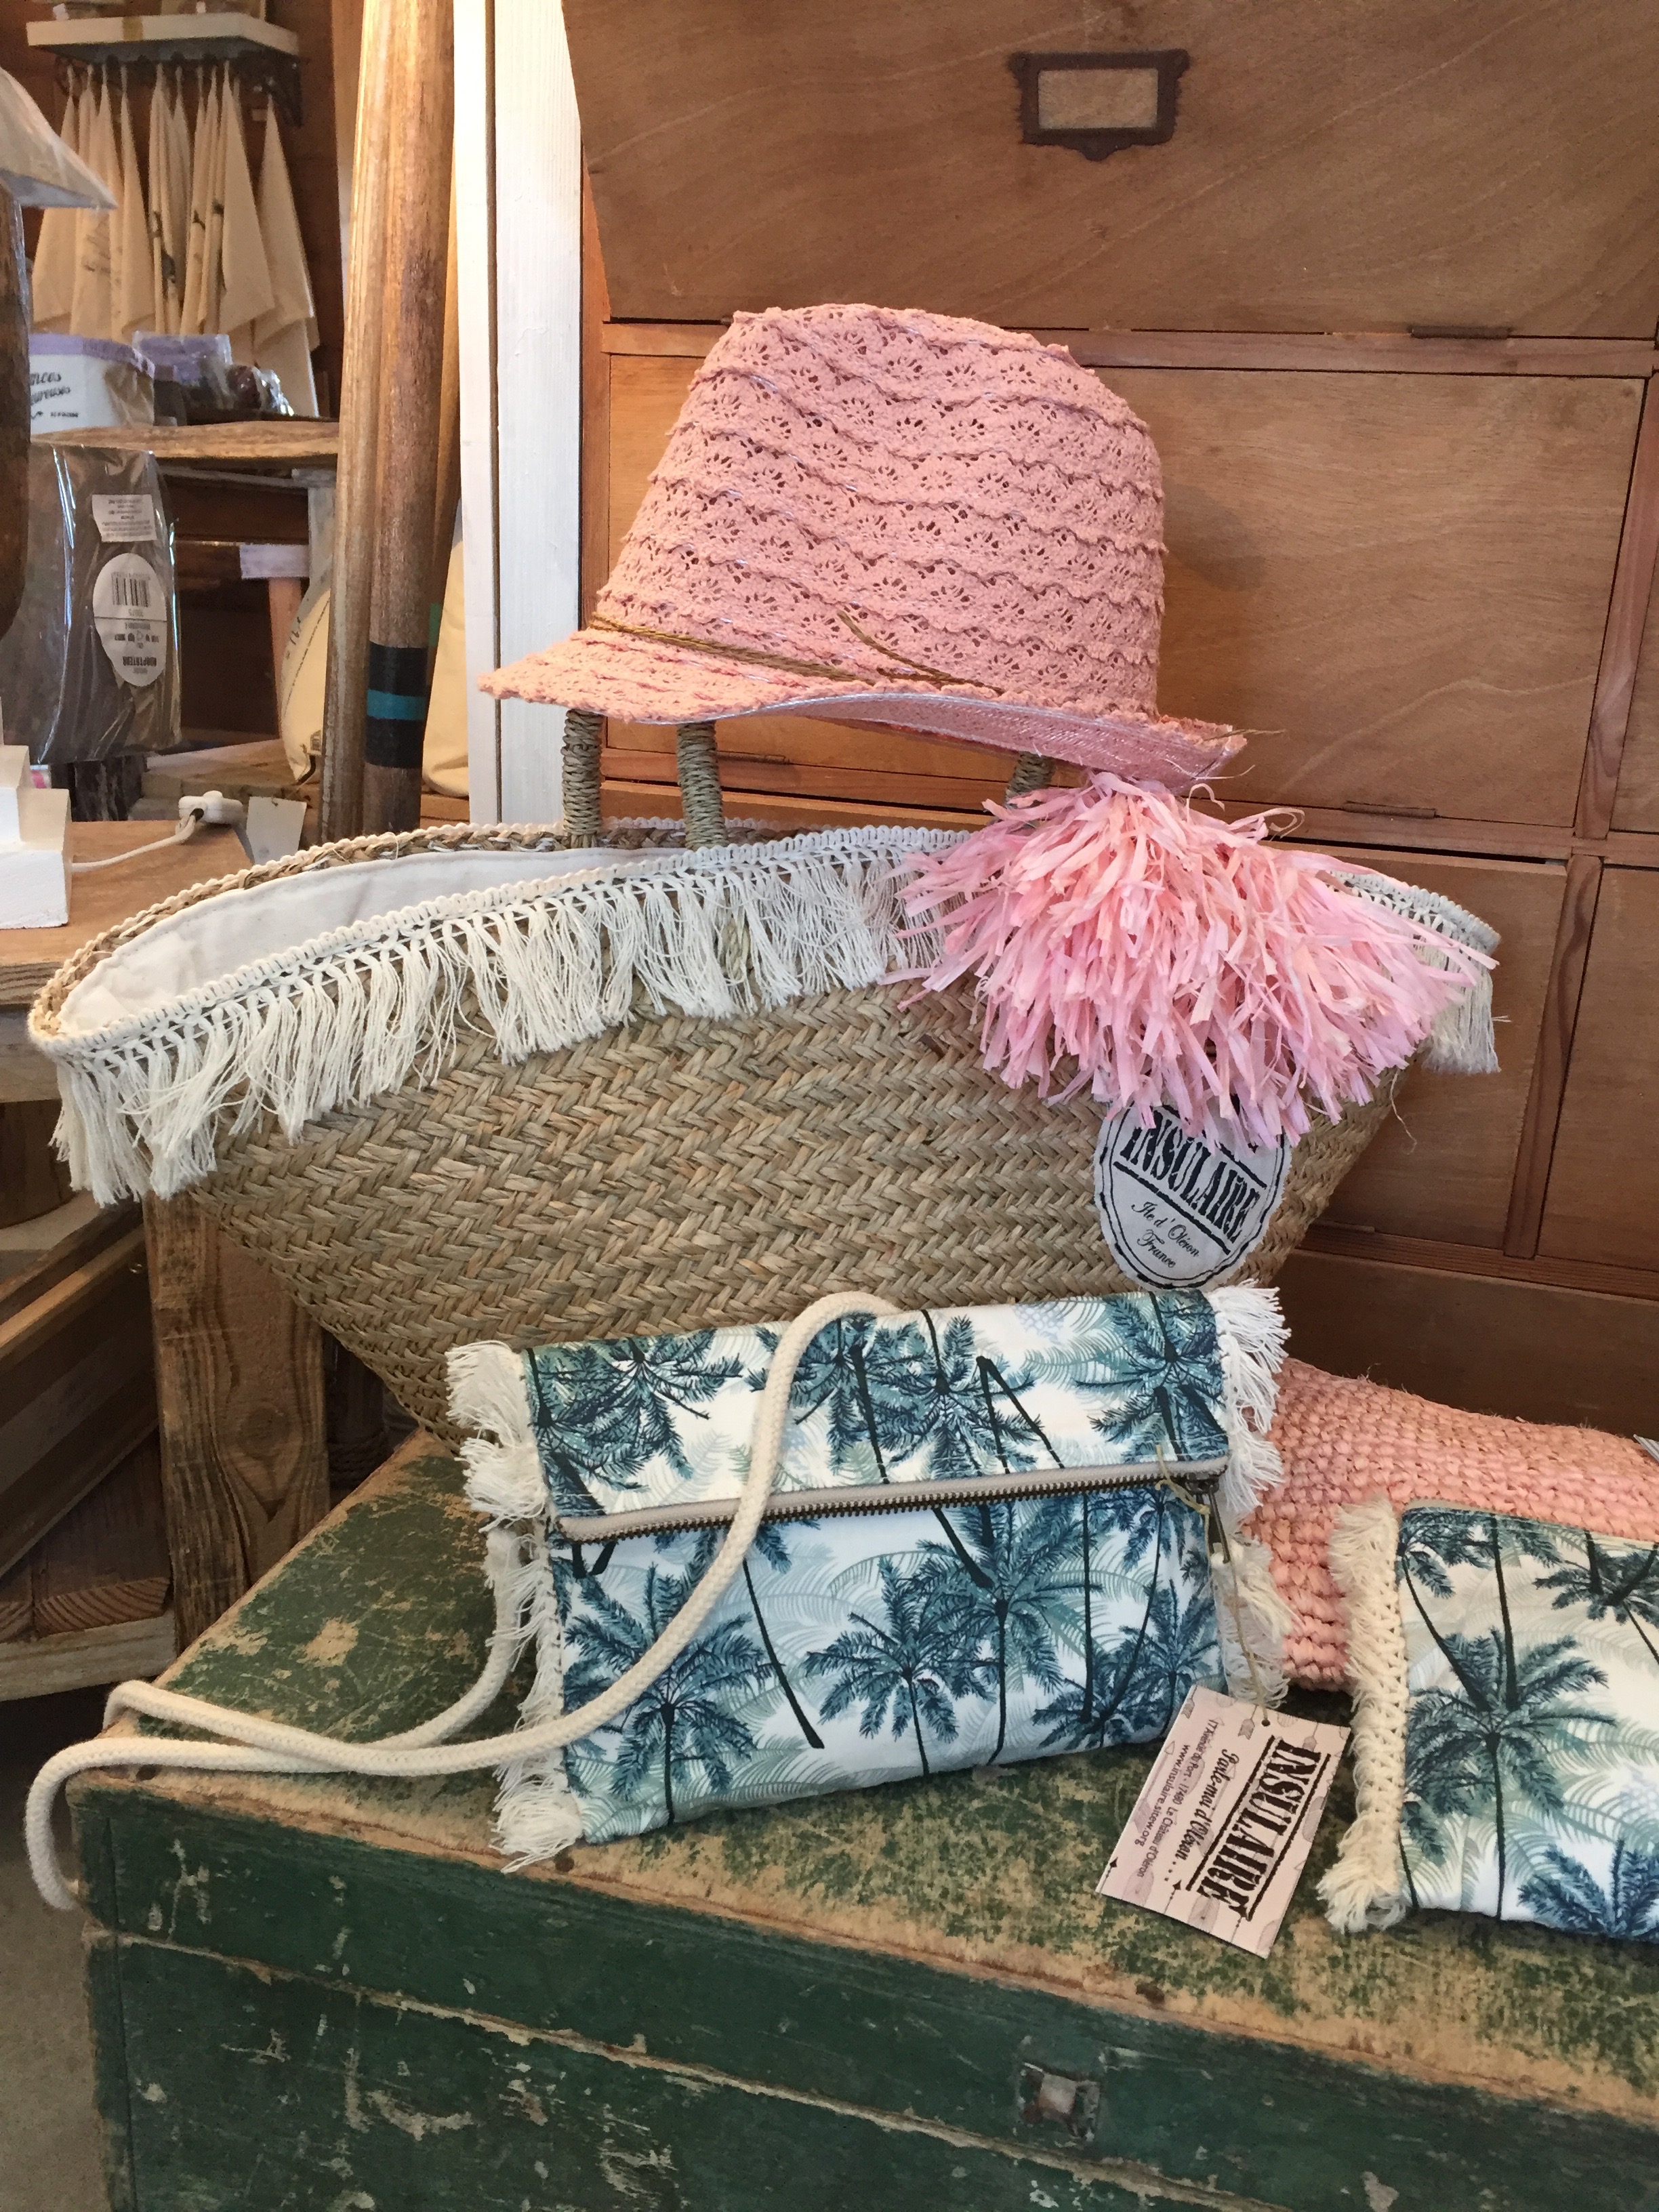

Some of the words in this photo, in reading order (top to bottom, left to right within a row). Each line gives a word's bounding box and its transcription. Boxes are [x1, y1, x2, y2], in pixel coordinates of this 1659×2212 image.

[1119, 1109, 1261, 1243] INSULAIRE
[1136, 1229, 1175, 1268] France
[1198, 1749, 1239, 1809] Parle-moi
[1197, 1738, 1322, 1919] INSULAIRE
